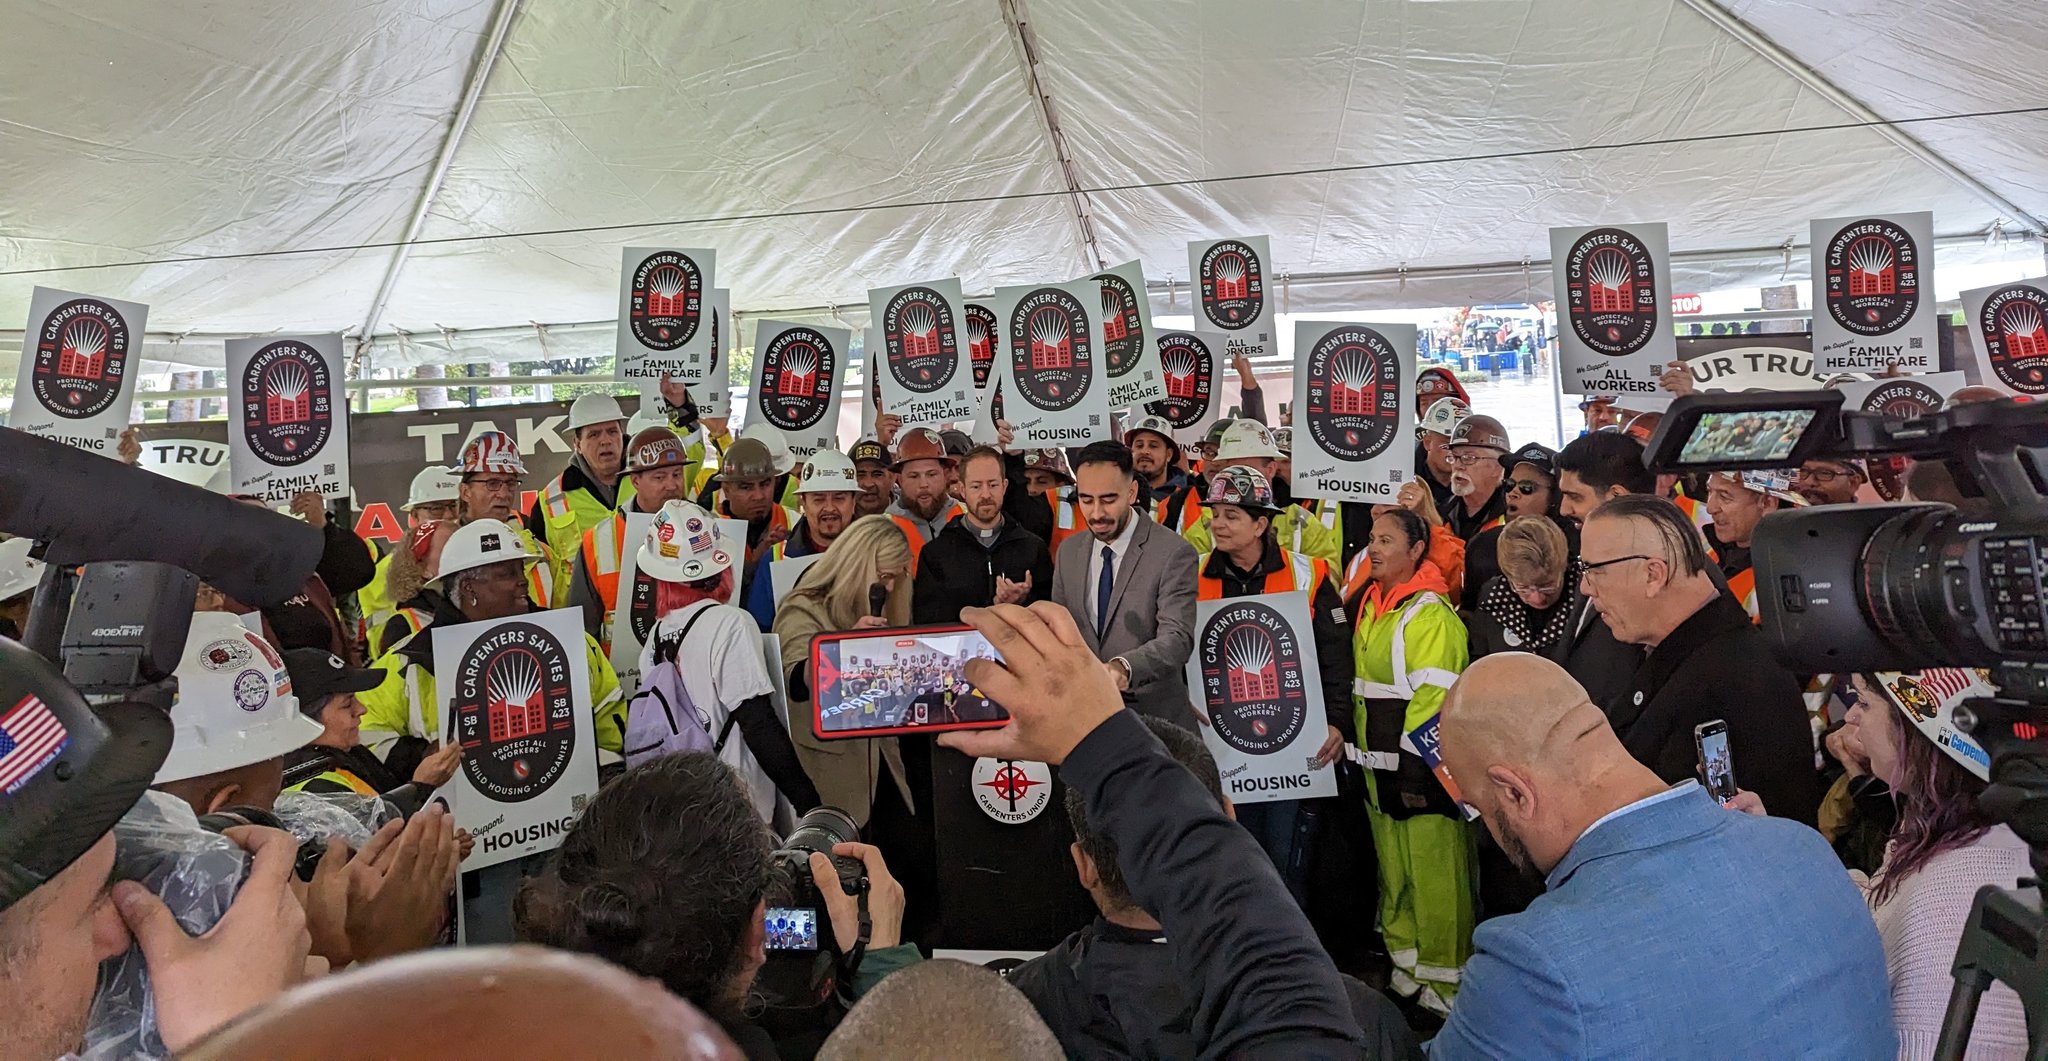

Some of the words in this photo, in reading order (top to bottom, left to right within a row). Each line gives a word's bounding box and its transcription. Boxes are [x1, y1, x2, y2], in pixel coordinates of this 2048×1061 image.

[1831, 225, 1881, 265] CARPENTERS
[1884, 228, 1904, 242] SAY
[1900, 243, 1911, 261] YES
[1572, 234, 1618, 278] CARPENTERS
[1620, 238, 1640, 254] SAY
[1637, 256, 1648, 277] YES
[636, 255, 678, 288] CARPENTERS
[679, 259, 694, 272] SAY
[690, 274, 698, 289] YES
[1638, 296, 1653, 304] 423
[888, 292, 924, 331] CARPENTERS
[926, 294, 942, 307] SAY
[939, 307, 949, 324] YES
[1015, 294, 1057, 337] CARPENTERS
[1059, 297, 1077, 312] SAY
[1074, 314, 1084, 333] YES
[1833, 303, 1847, 321] BUILD
[1847, 320, 1880, 331] HOUSING
[1887, 300, 1912, 328] ORGANIZE
[1985, 290, 2024, 331] CARPENTERS
[2027, 292, 2047, 304] SAY
[46, 304, 102, 339] CARPENTERS
[103, 312, 120, 328] SAY
[114, 331, 123, 349] YES
[1228, 339, 1246, 347] ALL
[1576, 320, 1589, 338] BUILD
[1590, 338, 1621, 351] HOUSING
[1628, 319, 1651, 348] ORGANIZE
[41, 350, 52, 358] SB
[768, 332, 813, 364] CARPENTERS
[813, 338, 828, 352] SAY
[822, 354, 830, 370] YES
[1313, 332, 1366, 376] CARPENTERS
[1368, 338, 1388, 355] SAY
[1383, 358, 1394, 379] YES
[1850, 346, 1903, 356] FAMILY
[248, 346, 297, 391] CARPENTERS
[299, 350, 318, 365] SAY
[314, 366, 325, 386] YES
[644, 360, 684, 368] FAMILY
[1690, 357, 1736, 383] UR
[1034, 370, 1060, 379] PROTECT
[1605, 369, 1631, 379] ALL
[1019, 377, 1031, 395] BUILD
[1032, 395, 1060, 406] HOUSING
[1066, 374, 1087, 402] ORGANIZE
[1108, 381, 1141, 397] AMILY
[1582, 380, 1656, 392] WORKERS
[38, 380, 49, 399] BUILD
[48, 399, 78, 415] HOUSING
[87, 388, 114, 413] ORGANIZE
[1381, 400, 1396, 408] 423
[1384, 392, 1394, 400] SB
[1916, 390, 1938, 407] SAY
[248, 403, 258, 411] SB
[910, 400, 951, 413] FAMILY
[27, 422, 54, 431] Support
[1021, 417, 1042, 429] Support
[1331, 416, 1361, 425] PROTECT
[1335, 422, 1370, 430] WORKERS
[1028, 428, 1091, 440] HOUSING
[1313, 421, 1326, 441] BUILD
[1326, 441, 1358, 456] HOUSING
[1366, 424, 1392, 454] ORGANIZE
[251, 434, 265, 452] BUILD
[265, 451, 296, 462] HOUSING
[303, 426, 326, 456] ORGANIZE
[1310, 466, 1335, 477] Support
[268, 474, 318, 490] FAMILY
[1318, 479, 1390, 495] HOUSING
[1958, 523, 1997, 533] Canon
[638, 584, 648, 592] SB
[637, 618, 648, 638] BUILD
[1206, 609, 1256, 663] CARPENTERS
[1259, 613, 1282, 631] SAY
[1279, 632, 1292, 656] YES
[464, 631, 525, 698] CARPENTERS
[528, 634, 553, 654] SAY
[549, 655, 563, 682] YES
[1208, 678, 1220, 686] SB
[1285, 670, 1297, 679] SB
[1212, 687, 1218, 695] 4
[1284, 679, 1301, 688] 423
[553, 697, 567, 708] SB
[1234, 703, 1266, 715] PROTECT
[1268, 704, 1281, 712] ALL
[463, 715, 477, 726] SB
[552, 707, 570, 718] 423
[1240, 709, 1277, 718] WORKERS
[467, 726, 475, 735] 4
[1215, 714, 1232, 736] BUILD
[1233, 735, 1269, 748] HOUSING
[1277, 707, 1300, 743] ORGANIZE
[492, 740, 529, 758] PROTECT
[532, 740, 546, 748] ALL
[499, 745, 542, 761] WORKERS
[469, 758, 488, 784] BUILD
[489, 782, 531, 795] HOUSING
[540, 739, 568, 784] ORGANIZE
[1221, 763, 1248, 779] Support
[1231, 774, 1310, 793] HOUSING
[980, 794, 1026, 820] CARPENTERS
[1027, 792, 1046, 816] UNION
[472, 814, 504, 838] Support
[483, 816, 573, 853] HOUSING
